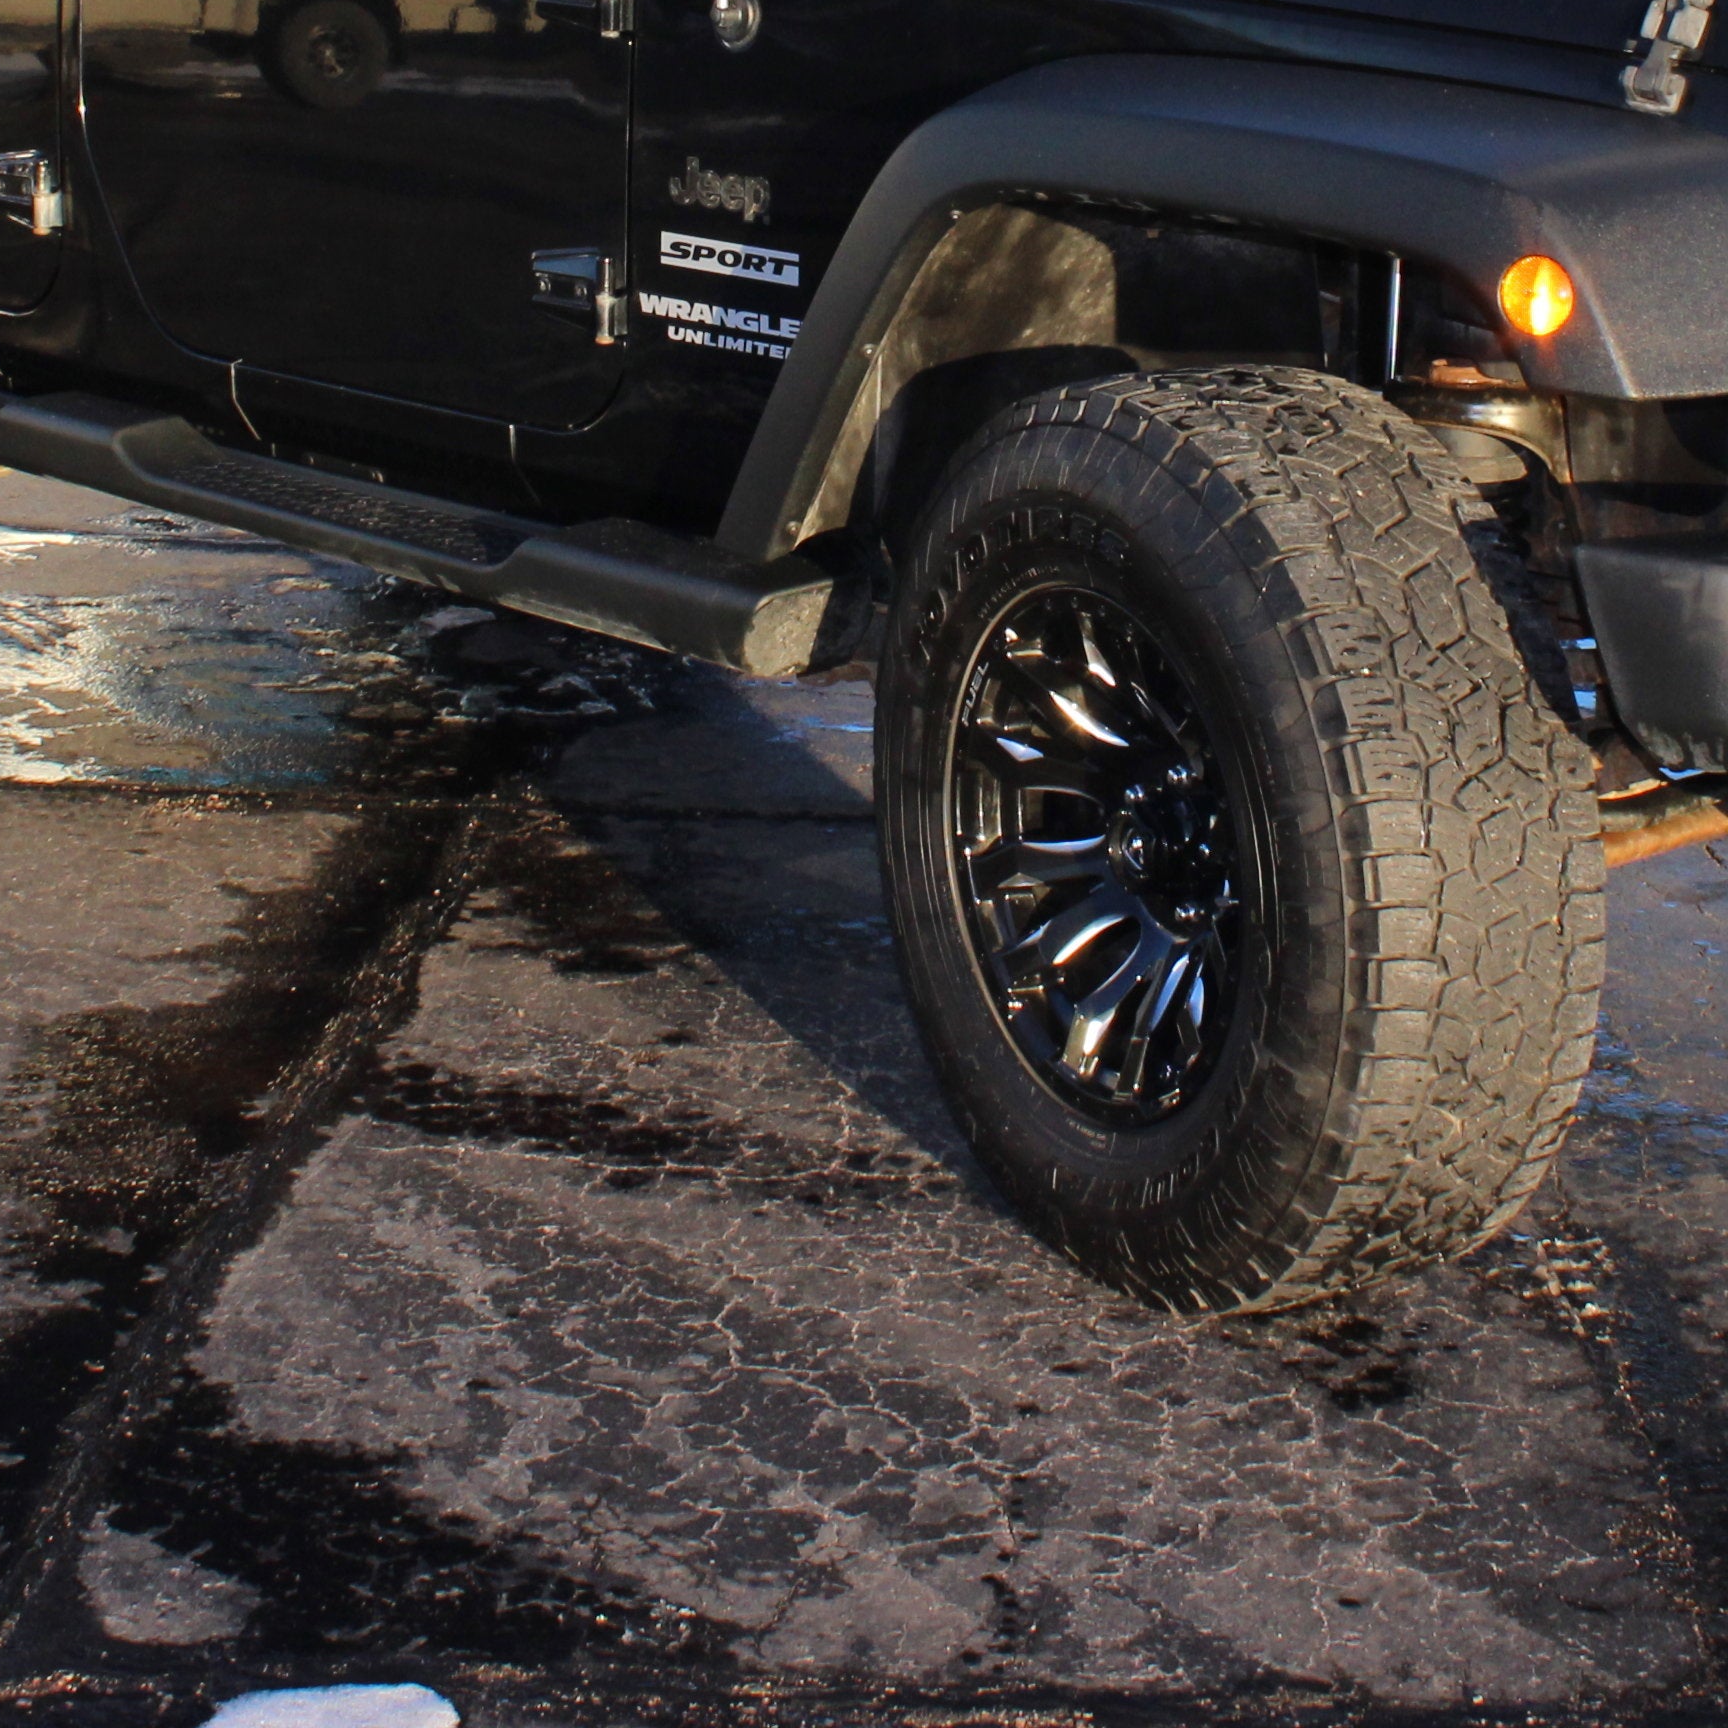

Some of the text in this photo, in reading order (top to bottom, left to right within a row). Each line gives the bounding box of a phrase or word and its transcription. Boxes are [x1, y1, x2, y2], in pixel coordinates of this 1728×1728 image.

[668, 155, 771, 223] Jeep
[661, 241, 800, 277] SPORT
[639, 291, 803, 339] WRANGLE
[667, 325, 794, 360] UNLIMITE
[961, 661, 990, 728] FUEL
